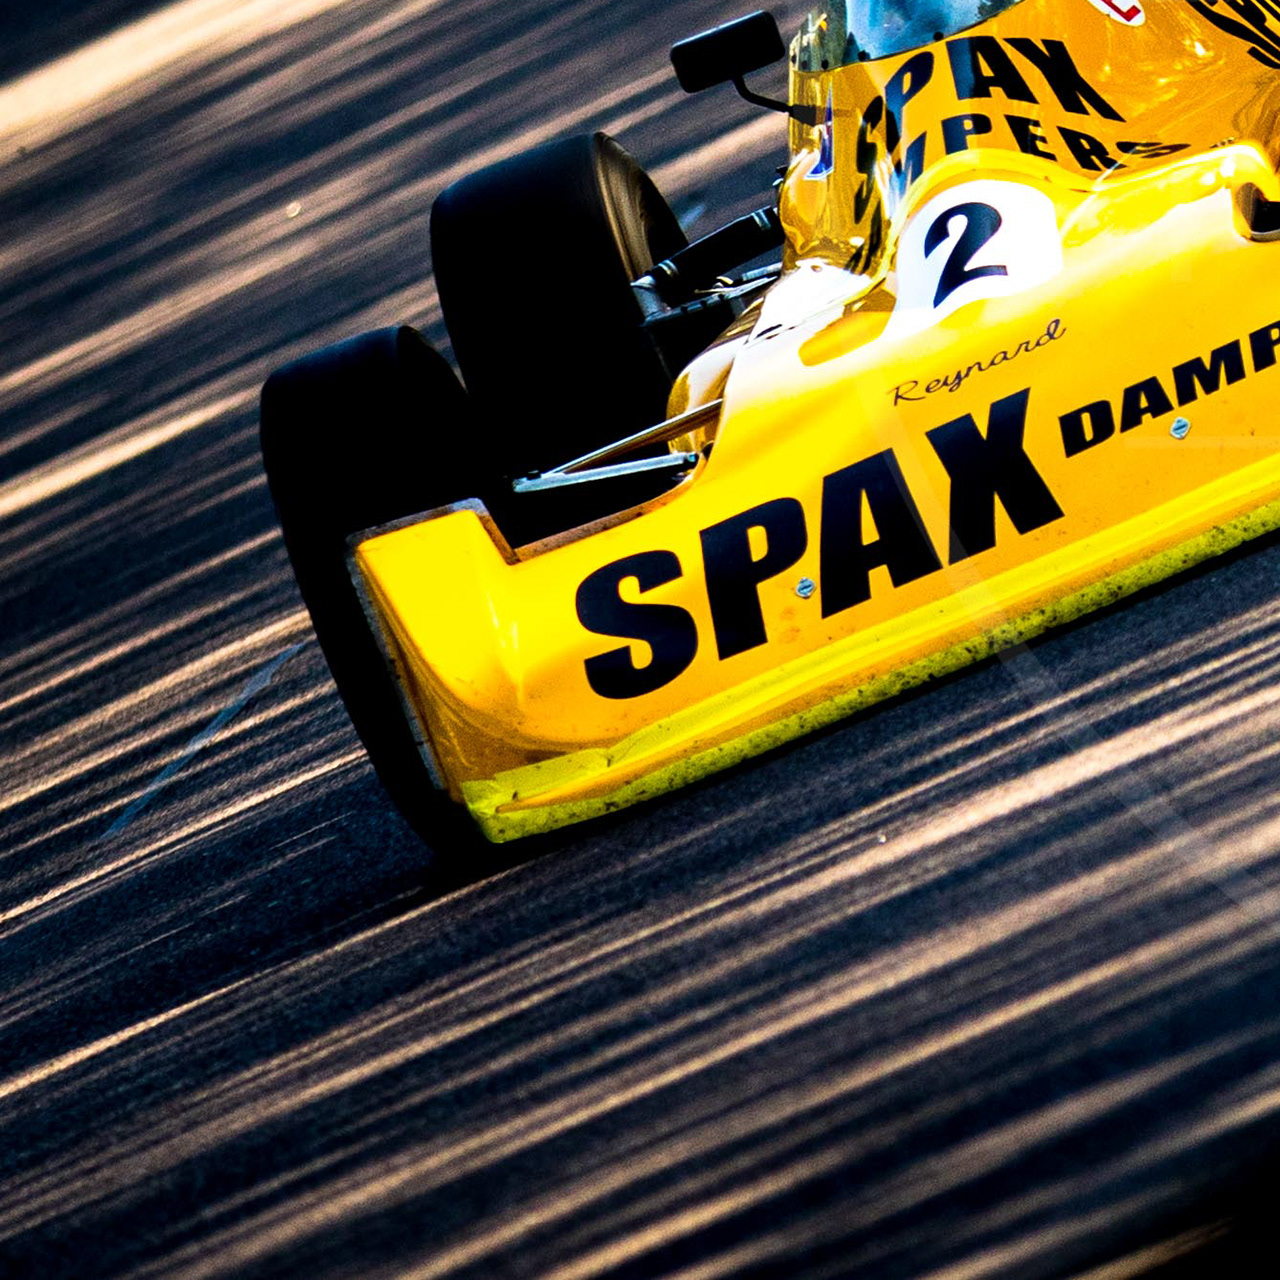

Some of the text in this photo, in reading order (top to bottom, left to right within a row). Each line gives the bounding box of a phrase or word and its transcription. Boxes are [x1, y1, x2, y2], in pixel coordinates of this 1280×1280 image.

[853, 35, 1126, 225] SPAX
[923, 201, 1009, 310] 2
[886, 318, 1067, 407] Reynard
[575, 387, 1066, 700] SPAX
